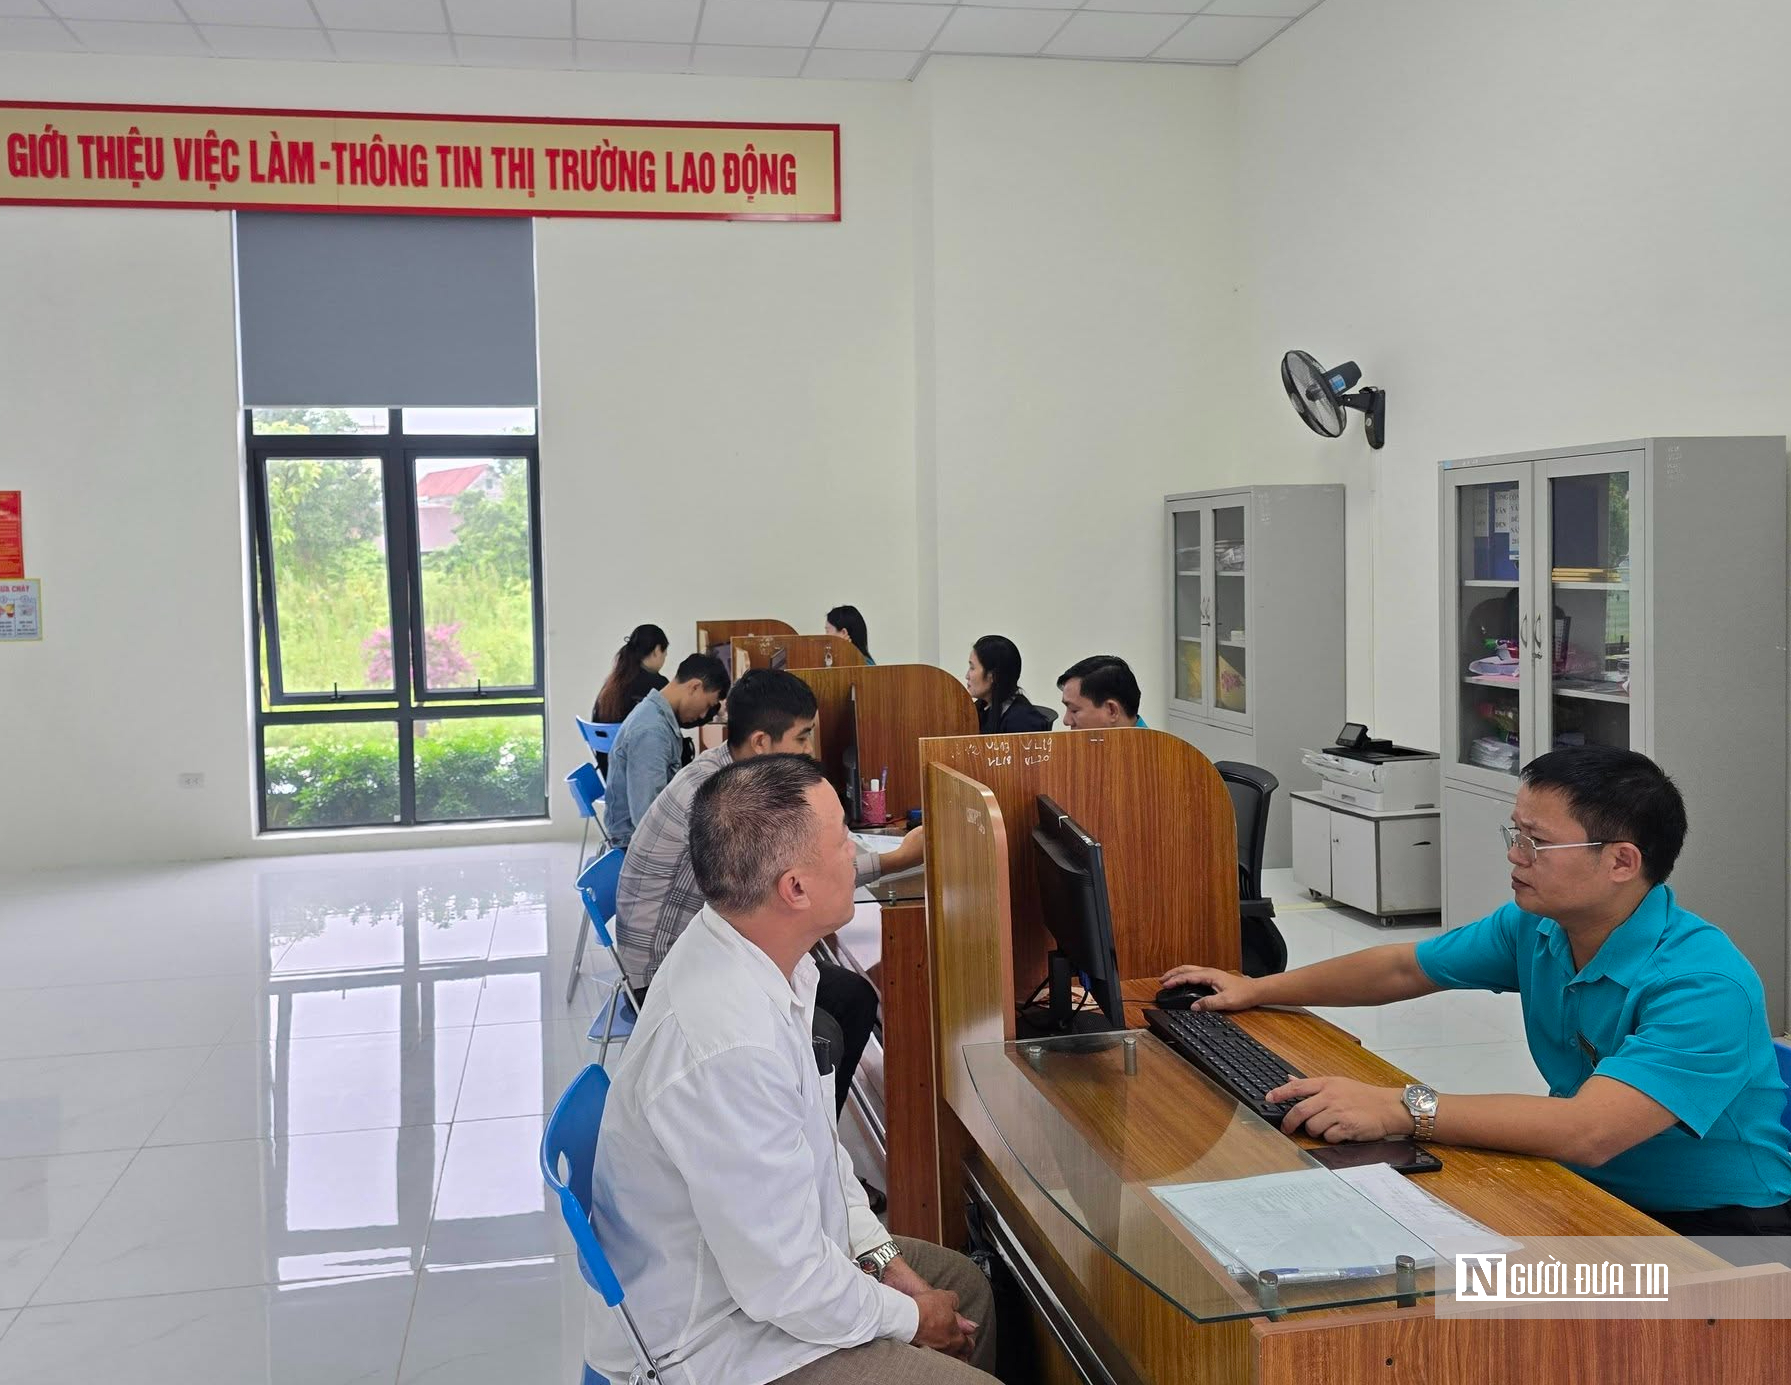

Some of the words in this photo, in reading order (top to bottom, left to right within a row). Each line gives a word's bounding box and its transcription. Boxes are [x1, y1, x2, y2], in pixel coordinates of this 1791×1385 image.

[7, 124, 70, 179] GIỚI
[77, 127, 165, 188] THIỆU
[173, 129, 240, 190] VIỆC
[435, 144, 483, 188] TIN
[490, 146, 535, 198] THỊ
[544, 139, 657, 193] TRƯỜNG
[665, 150, 717, 195] LAO
[722, 143, 797, 203] ĐỘNG
